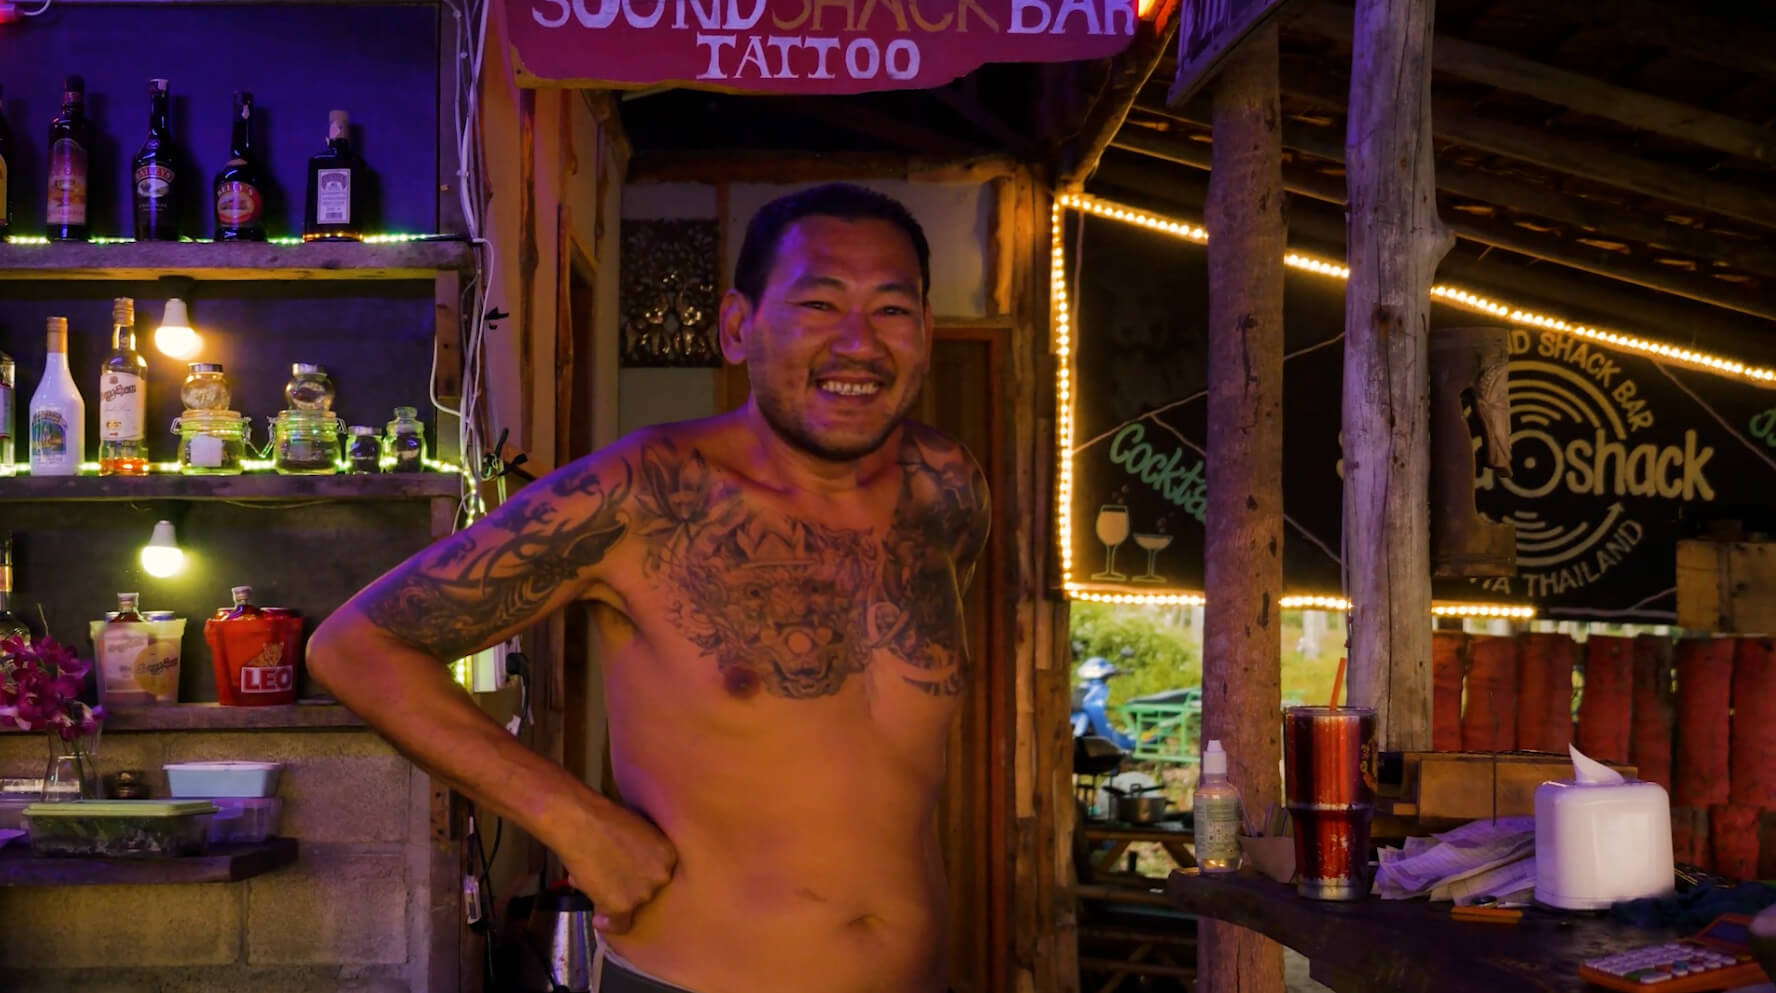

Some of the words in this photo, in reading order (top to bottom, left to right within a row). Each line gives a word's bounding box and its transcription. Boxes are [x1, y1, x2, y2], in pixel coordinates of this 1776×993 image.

[696, 31, 921, 80] TATTOO
[1537, 331, 1621, 388] SHACK
[1611, 379, 1654, 433] BAR
[1566, 429, 1715, 501] shack
[1522, 519, 1643, 598] THAILAND
[243, 668, 292, 691] LEO
